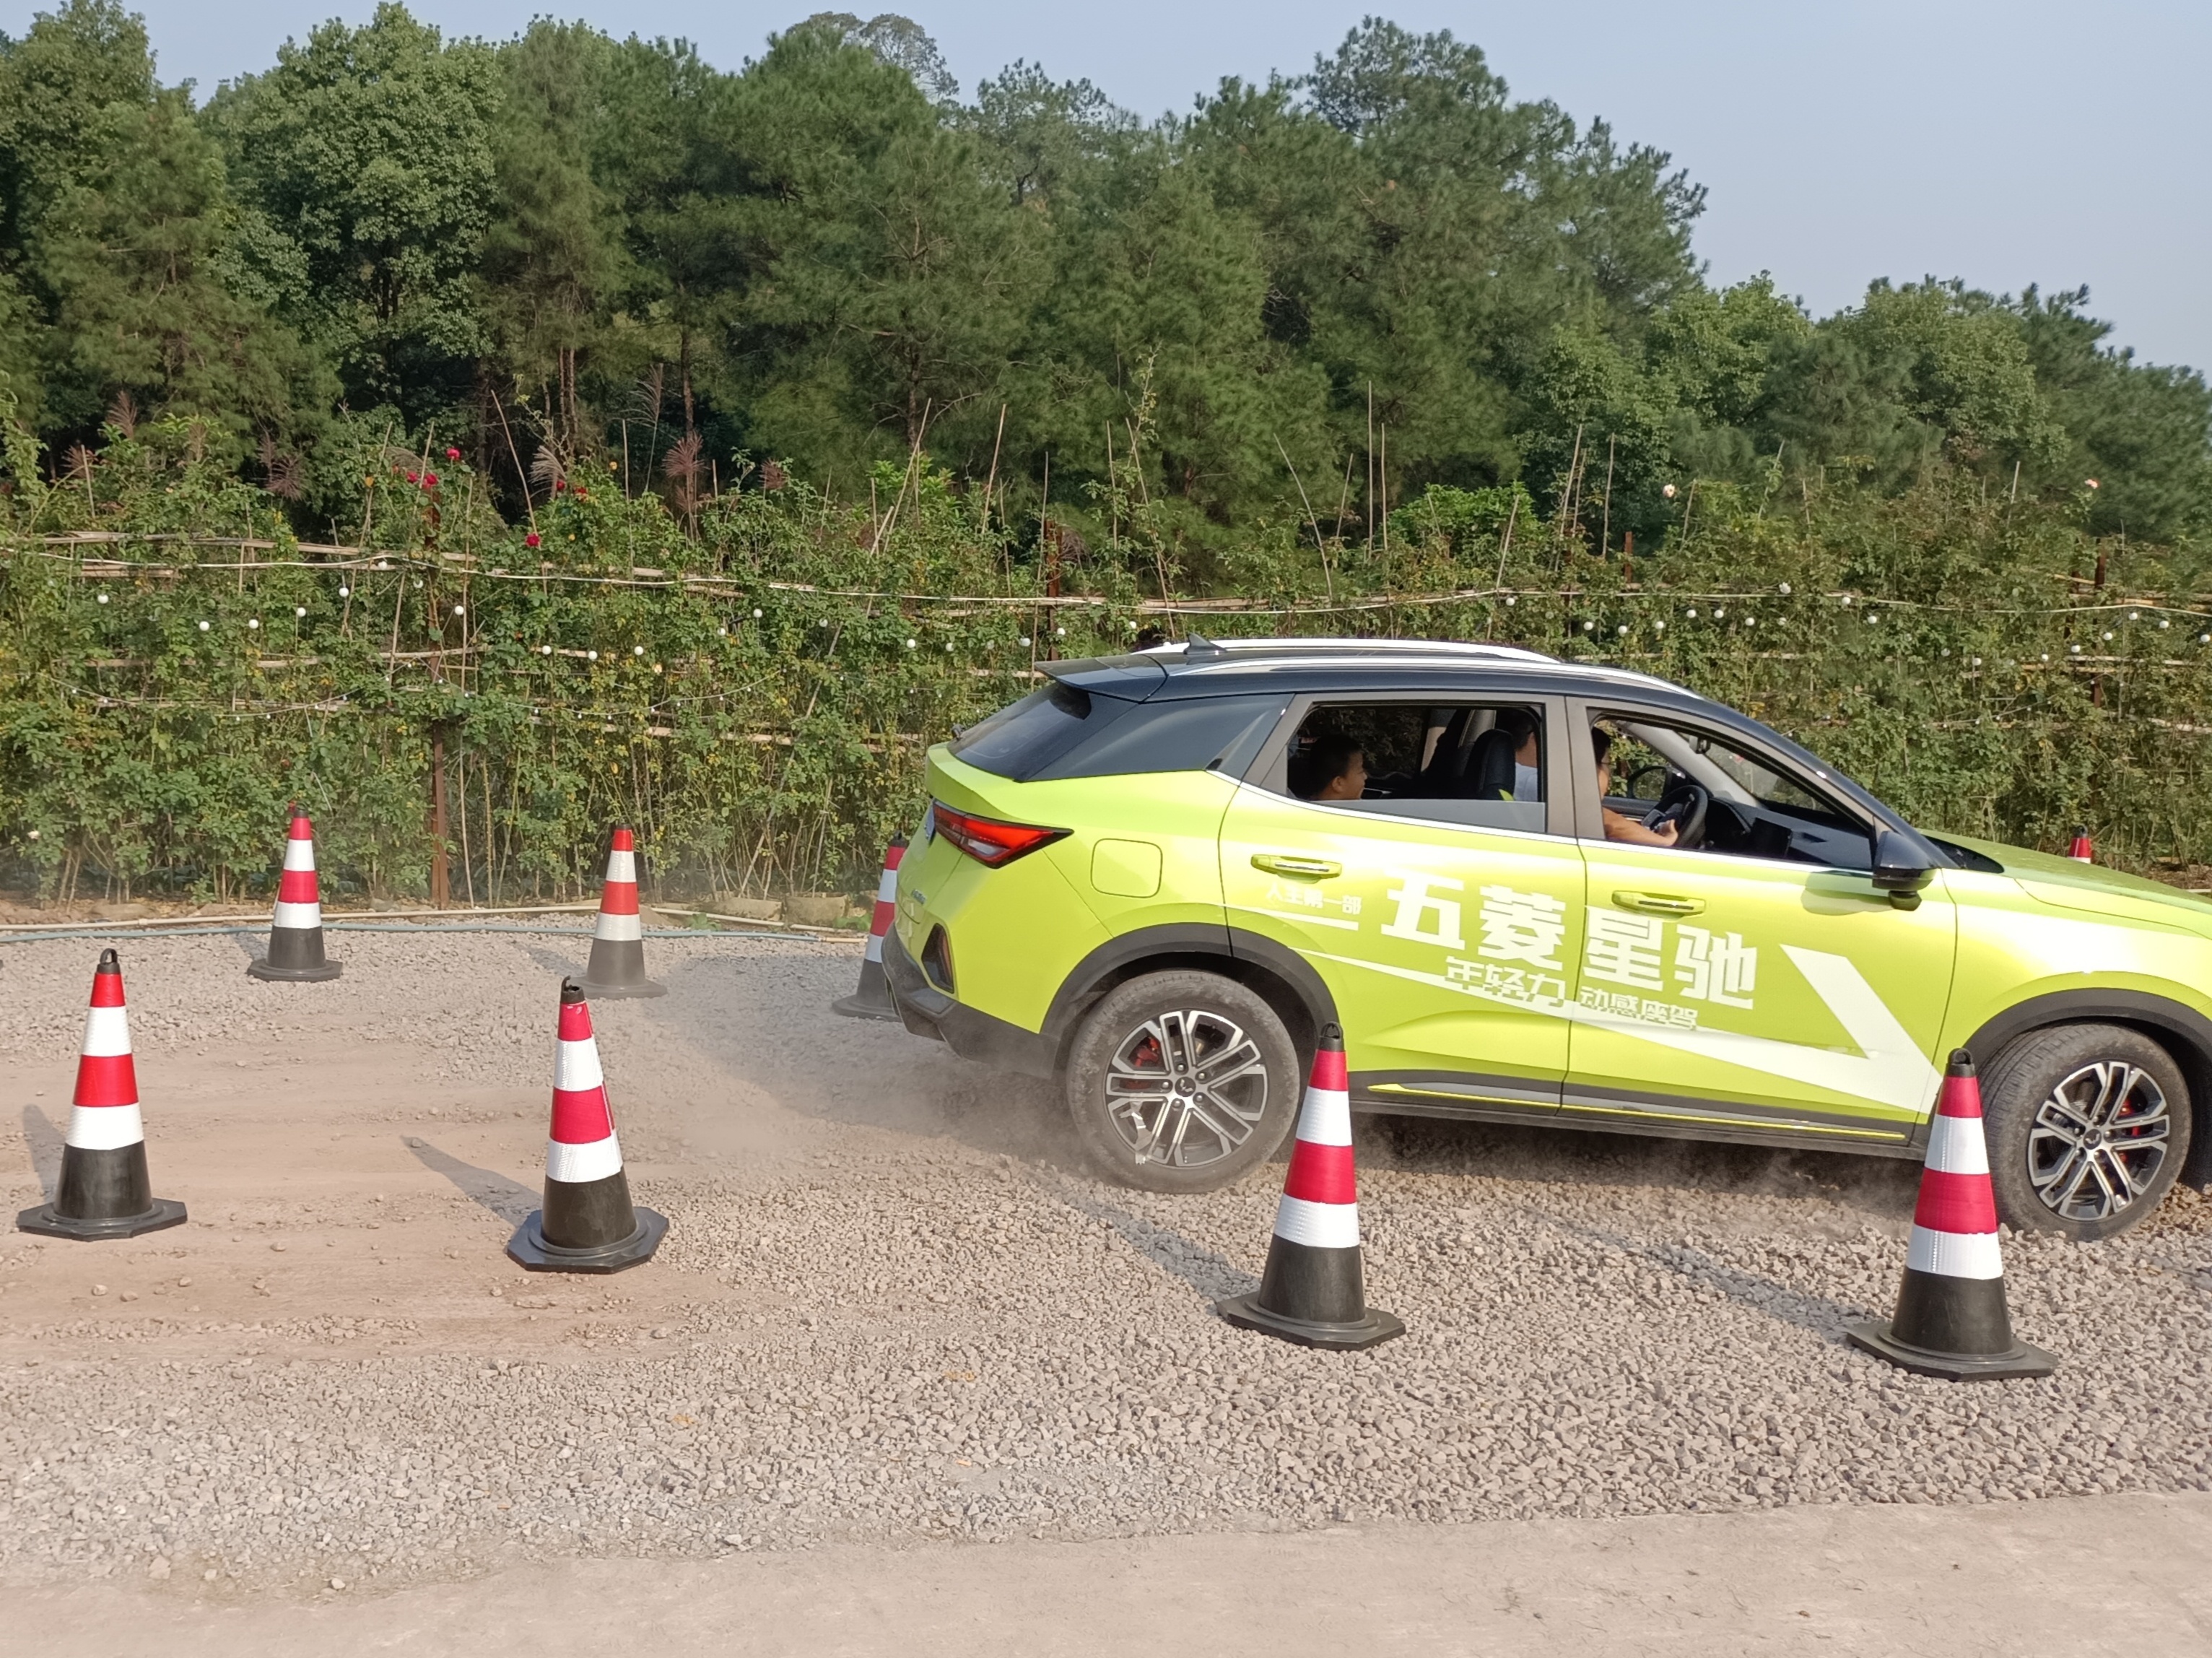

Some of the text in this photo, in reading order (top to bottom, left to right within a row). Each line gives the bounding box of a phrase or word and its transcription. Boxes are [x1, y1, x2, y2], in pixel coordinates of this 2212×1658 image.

[1380, 869, 1757, 1010] 五菱星驰
[1445, 955, 1699, 1031] 年轻力 动感座驾
